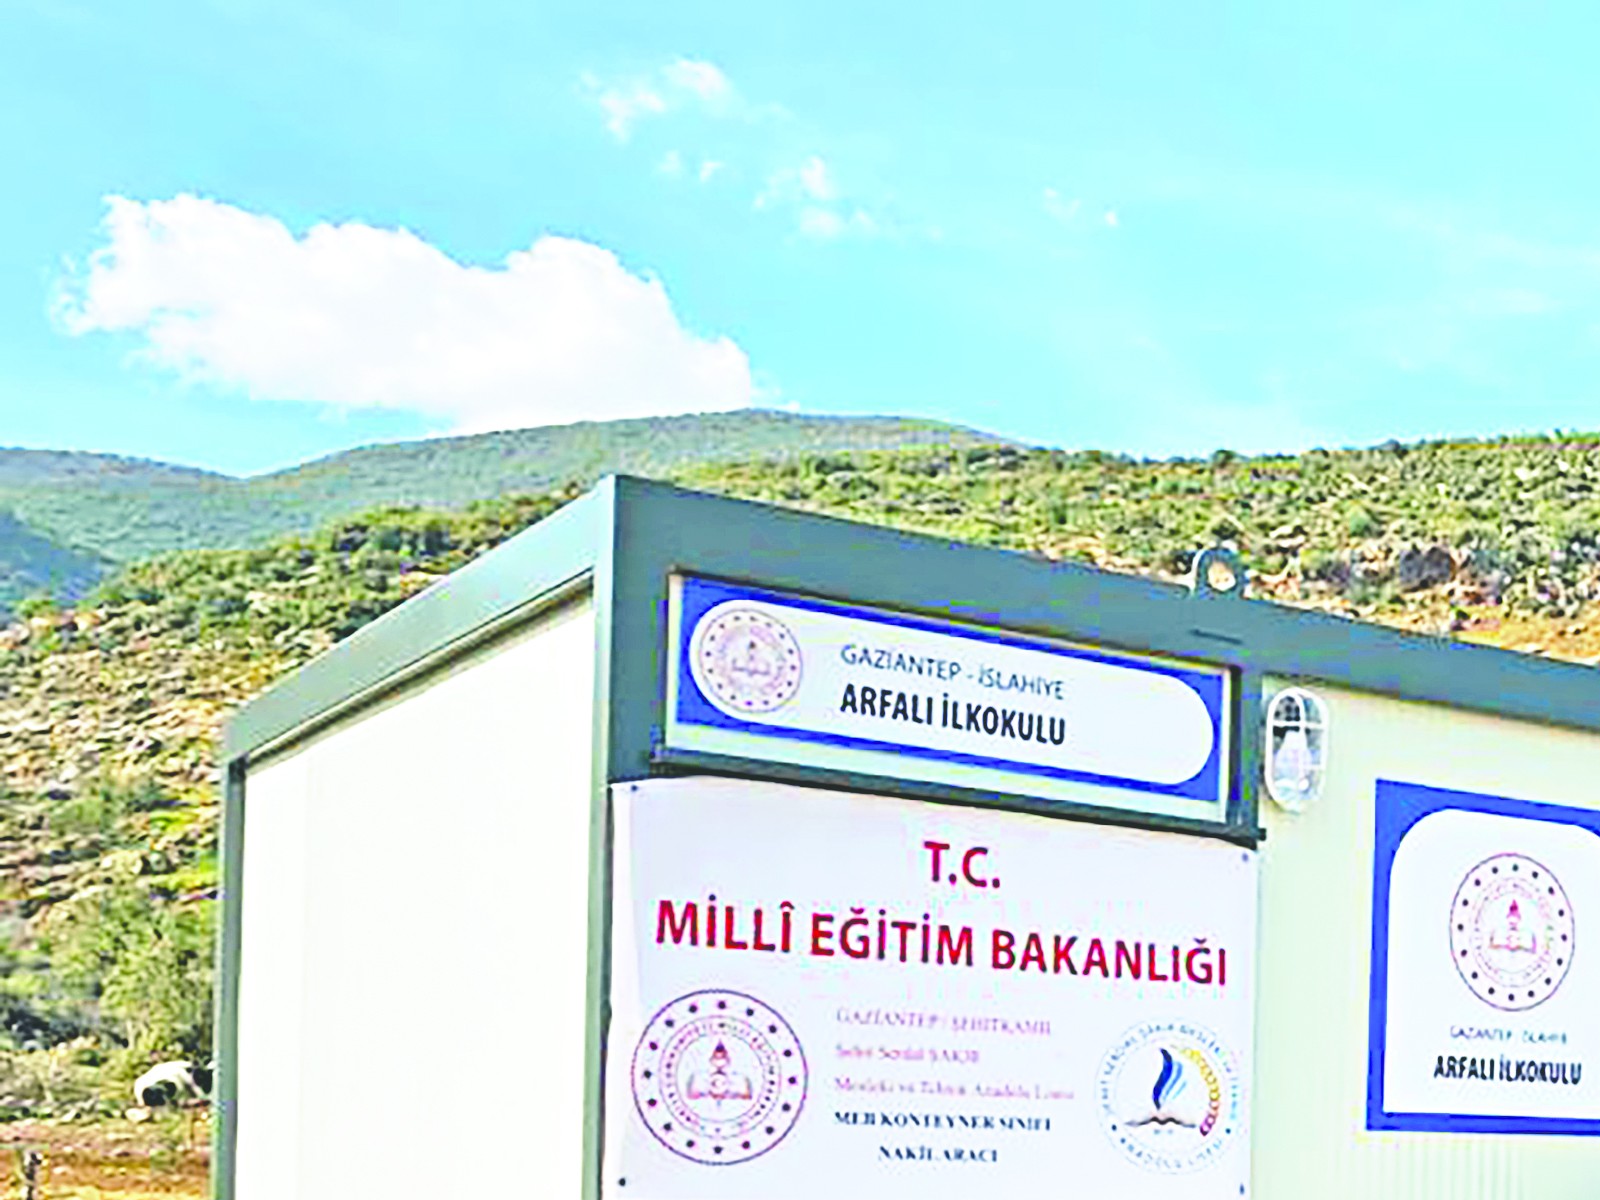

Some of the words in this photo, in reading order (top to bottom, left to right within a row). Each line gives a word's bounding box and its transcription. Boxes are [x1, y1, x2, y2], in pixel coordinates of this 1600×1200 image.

[840, 683, 933, 726] ARFALI
[942, 692, 1065, 746] İLKOKULU
[923, 840, 1000, 889] T.C.
[655, 893, 796, 954] MİLLÎ
[809, 905, 974, 967] EĞİTİM
[991, 929, 1226, 986] BAKANLIĞI
[1433, 1055, 1495, 1082] ARFALI
[1498, 1053, 1583, 1086] İLKOKULU
